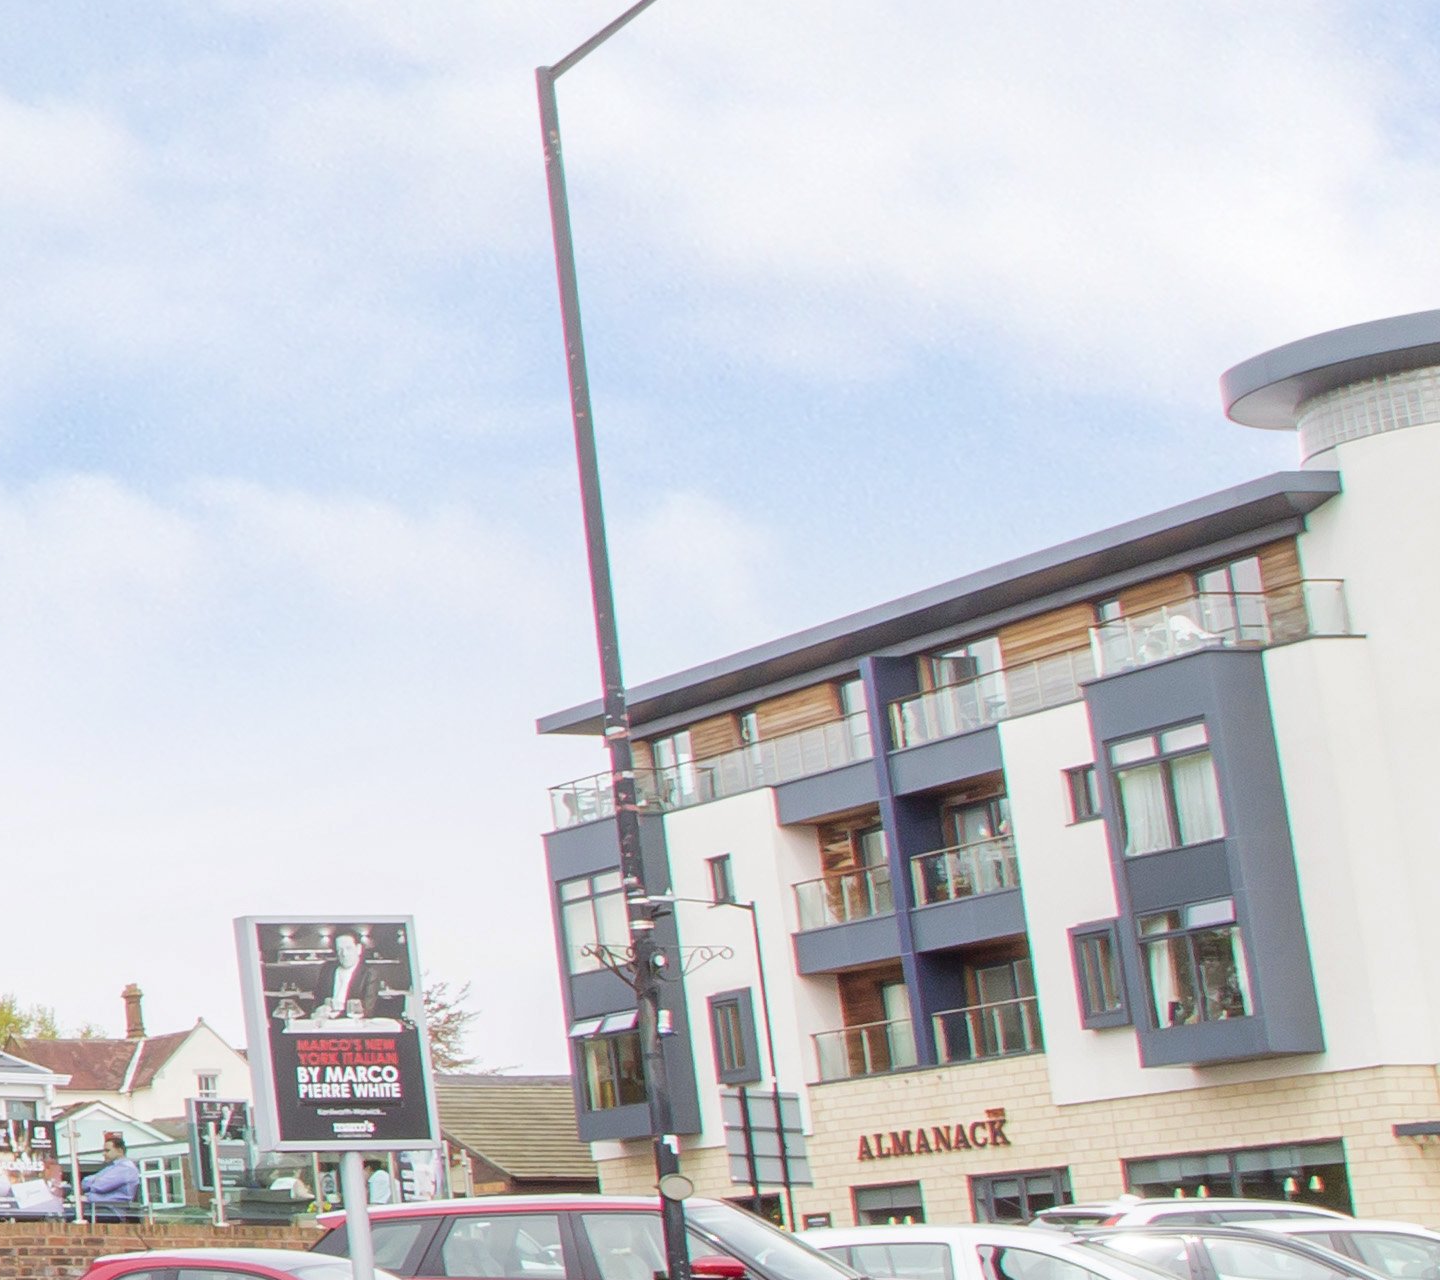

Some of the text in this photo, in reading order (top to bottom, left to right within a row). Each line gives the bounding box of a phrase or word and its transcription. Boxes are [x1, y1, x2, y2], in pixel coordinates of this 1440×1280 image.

[296, 1065, 399, 1082] BY MARCO
[298, 1083, 402, 1098] PIERRE WHITE
[857, 1119, 1011, 1161] ALMANACK
